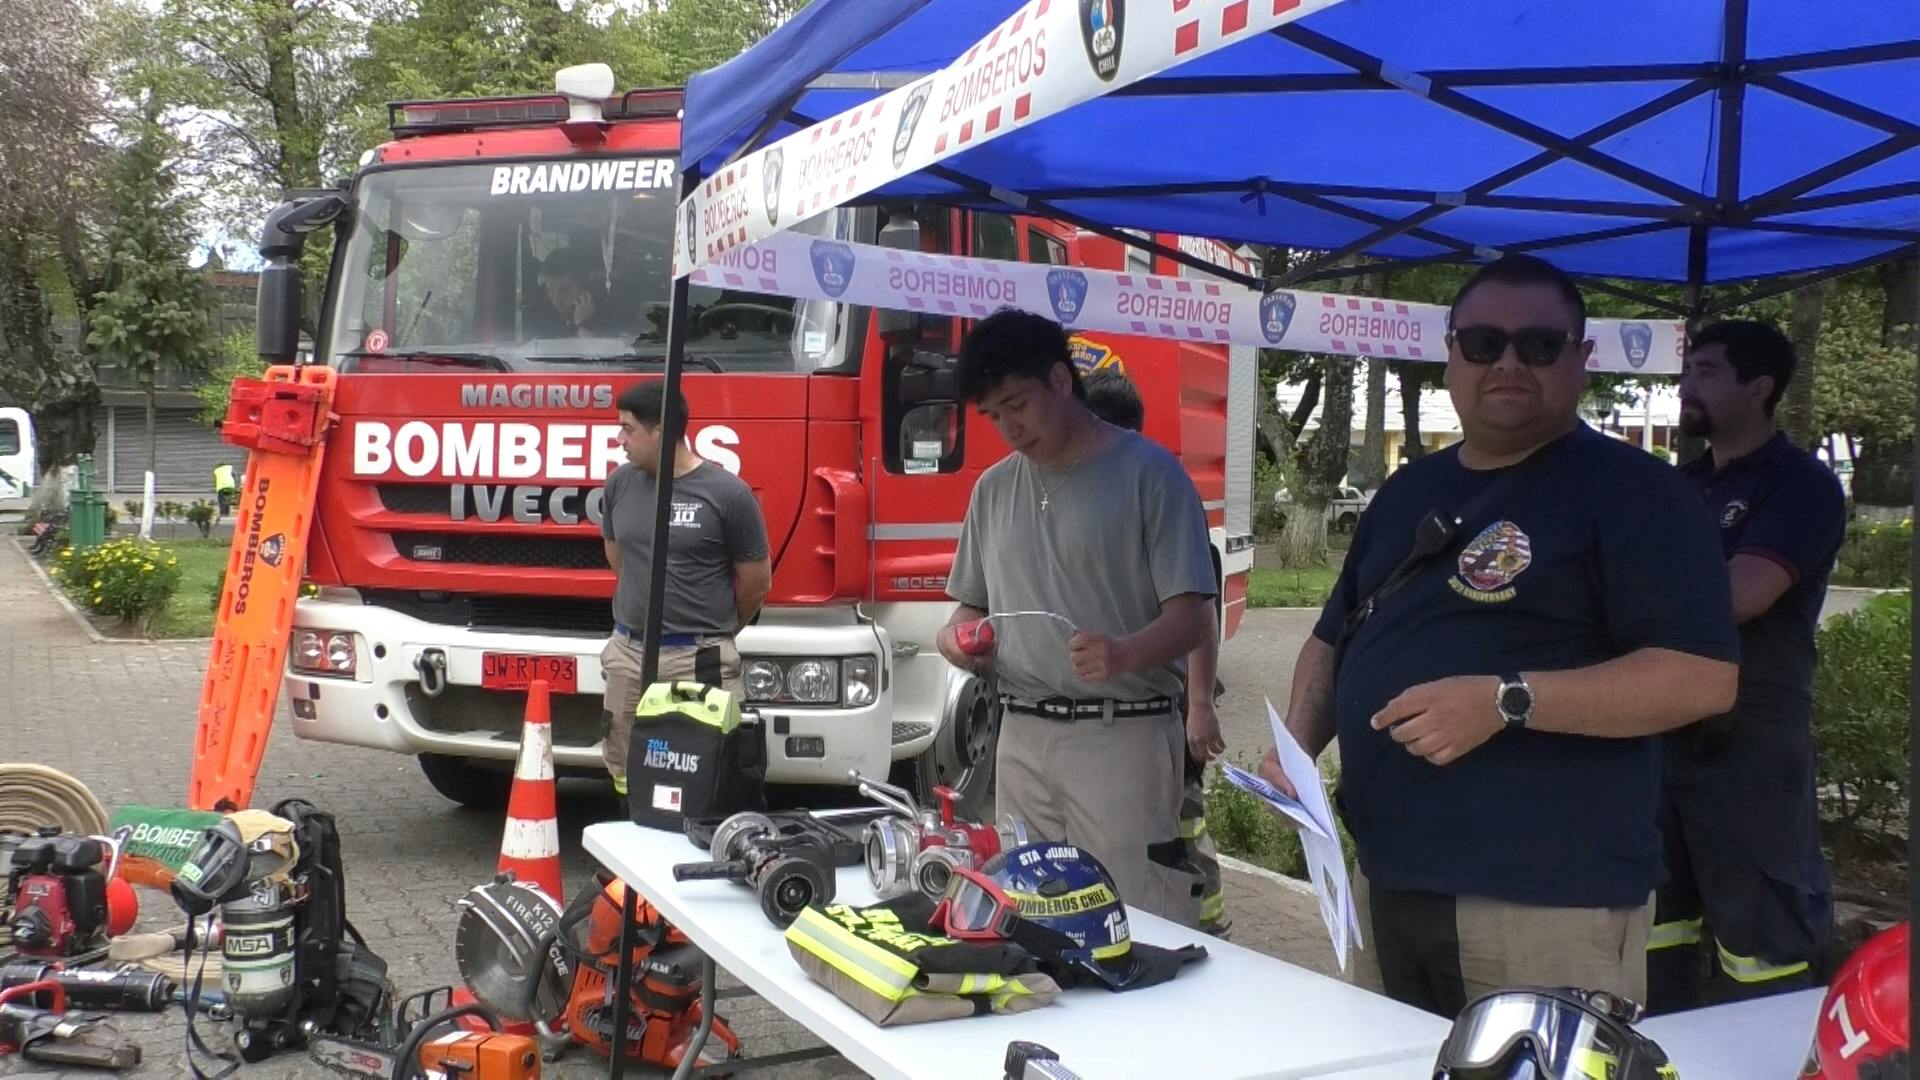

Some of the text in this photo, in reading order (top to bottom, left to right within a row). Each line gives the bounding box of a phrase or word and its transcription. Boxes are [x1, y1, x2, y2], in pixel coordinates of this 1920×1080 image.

[940, 28, 1047, 124] BOMBEROS
[491, 159, 675, 195] BRANDWEER
[799, 127, 876, 189] BOMBEROS
[704, 187, 749, 237] BOMBEROS
[461, 384, 613, 408] MAGIRUS
[354, 421, 741, 479] BOMBERS
[449, 484, 603, 524] IVEC
[673, 510, 696, 523] 10
[235, 477, 270, 616] BOMBEROS
[1018, 848, 1042, 866] STA
[532, 902, 554, 928] K12
[1079, 888, 1108, 908] CHILE
[226, 936, 271, 953] MSA
[1828, 993, 1870, 1059] 1
